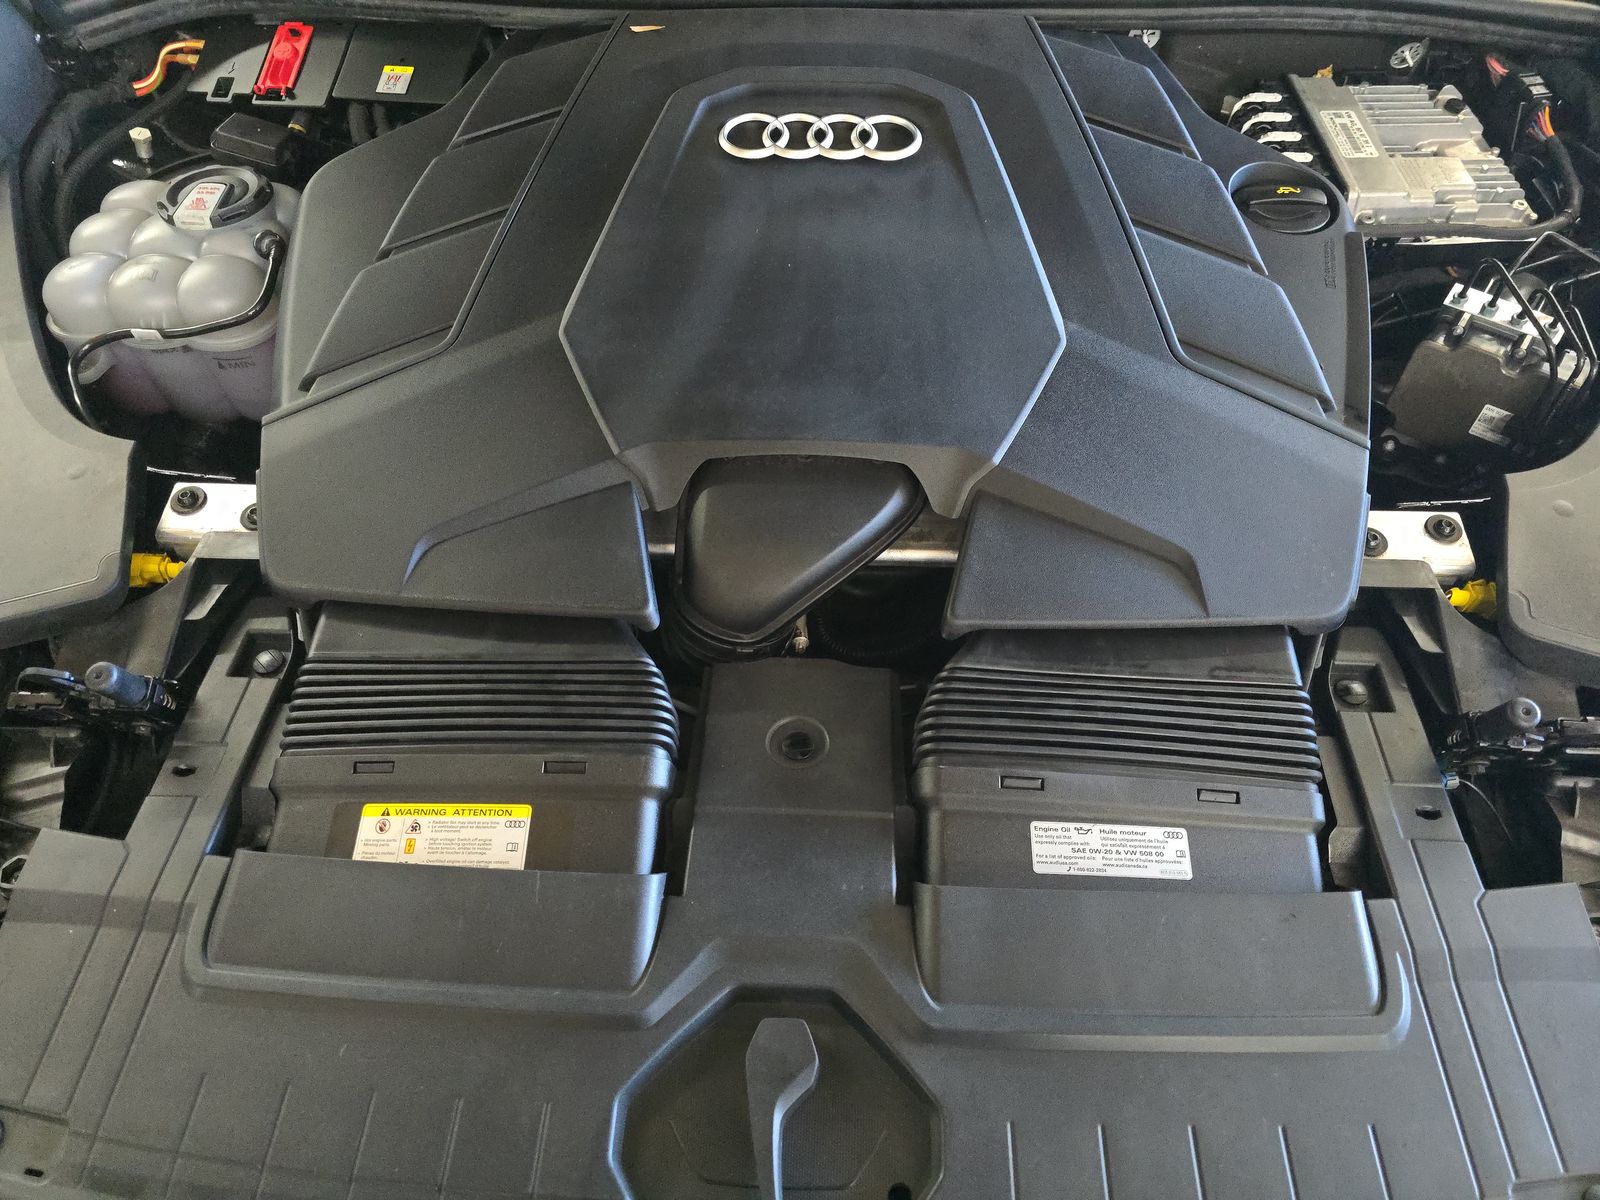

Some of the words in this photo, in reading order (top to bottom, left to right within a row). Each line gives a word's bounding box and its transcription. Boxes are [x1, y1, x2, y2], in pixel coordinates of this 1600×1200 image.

[228, 361, 256, 369] MIN
[395, 808, 447, 816] WARNING
[452, 808, 513, 817] ATTENTION
